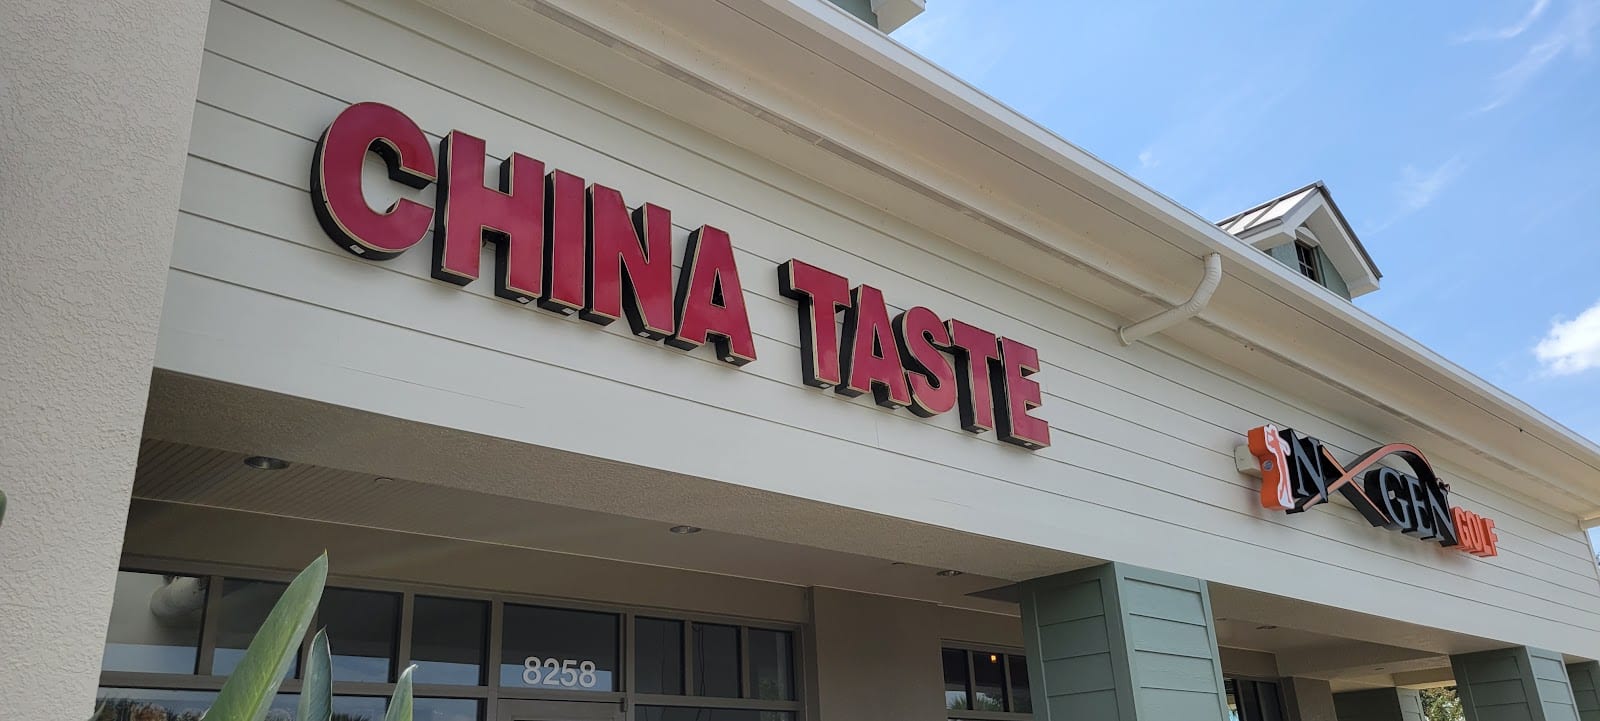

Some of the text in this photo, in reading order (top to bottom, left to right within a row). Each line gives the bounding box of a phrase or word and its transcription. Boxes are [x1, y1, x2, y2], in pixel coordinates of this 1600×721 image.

[312, 101, 1051, 451] CHINA TASTE
[1454, 506, 1498, 556] GOLF
[522, 656, 597, 688] 8258
